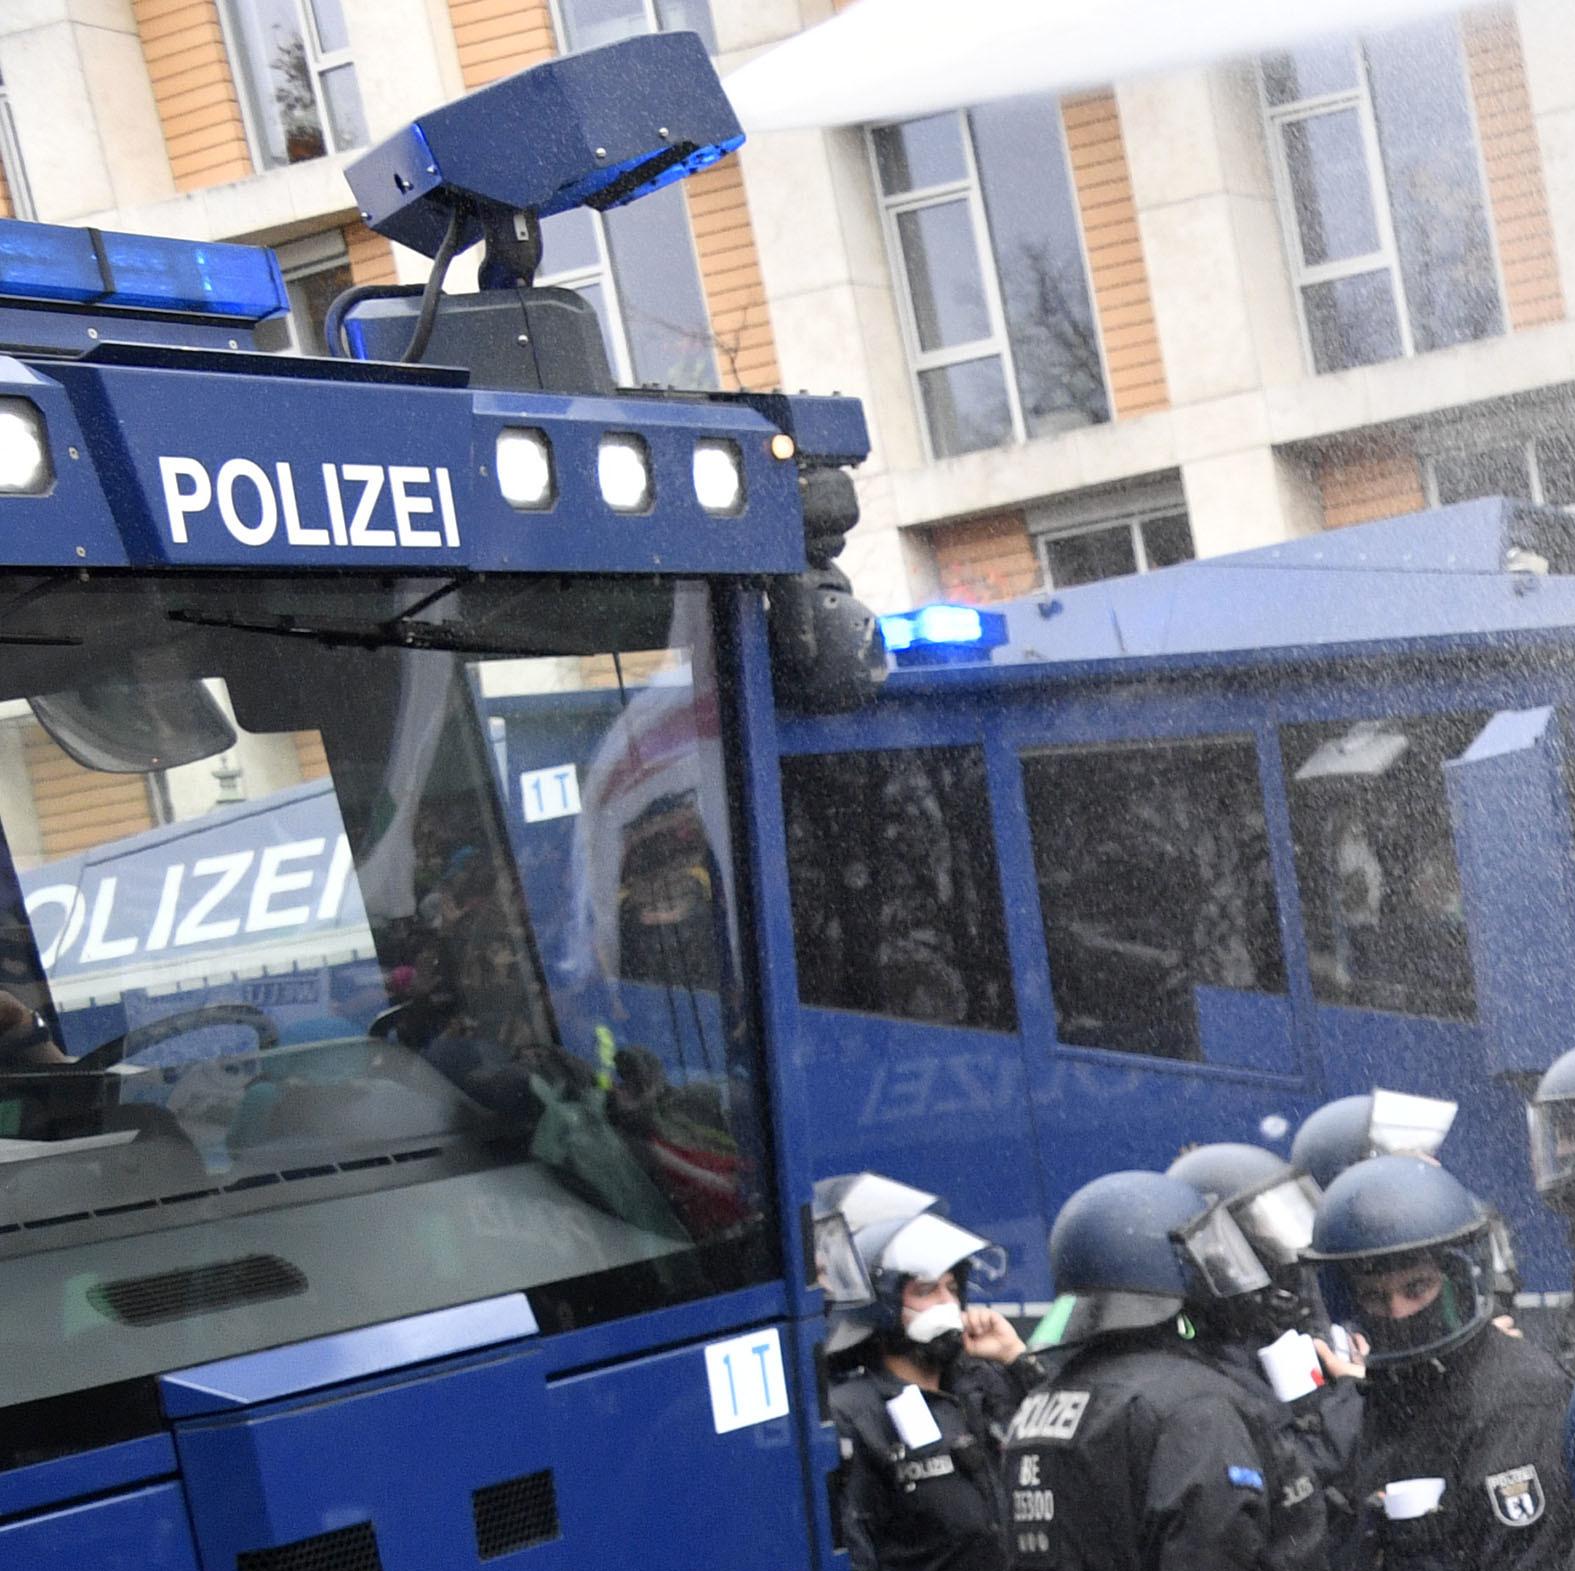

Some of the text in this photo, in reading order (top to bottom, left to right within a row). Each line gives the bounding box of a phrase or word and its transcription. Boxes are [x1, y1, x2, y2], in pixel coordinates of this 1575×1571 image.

[158, 455, 461, 549] POLIZEI
[24, 834, 353, 969] OLIZEI
[1006, 1391, 1091, 1443] POLIZEI
[1019, 1454, 1041, 1486] BE
